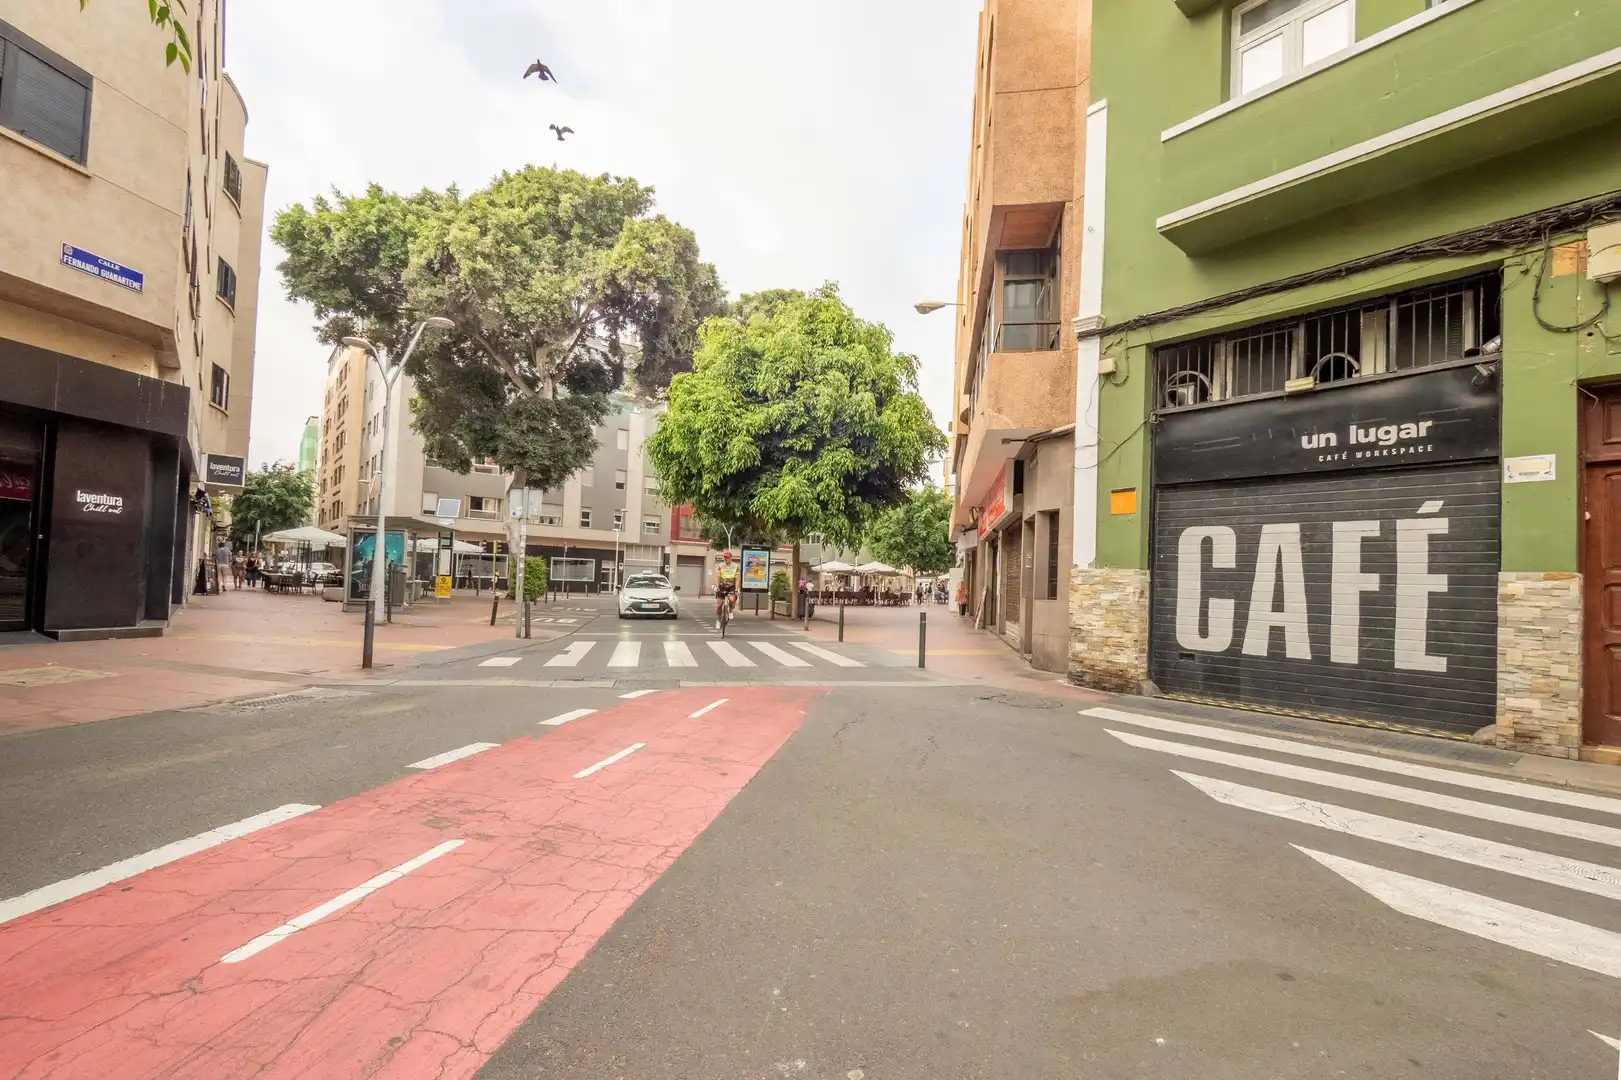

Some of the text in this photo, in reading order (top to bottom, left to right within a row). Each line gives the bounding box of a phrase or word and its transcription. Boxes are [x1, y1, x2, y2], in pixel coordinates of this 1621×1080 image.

[63, 255, 142, 290] FERNANDO GUANARTEME
[98, 259, 120, 271] CALLE
[1301, 420, 1433, 449] un lugar
[1318, 444, 1434, 462] CAFÉ WORKSPACE
[210, 462, 241, 473] laventura
[76, 489, 123, 506] laventura
[83, 502, 108, 512] Chill
[1176, 500, 1449, 672] CAFÉ
